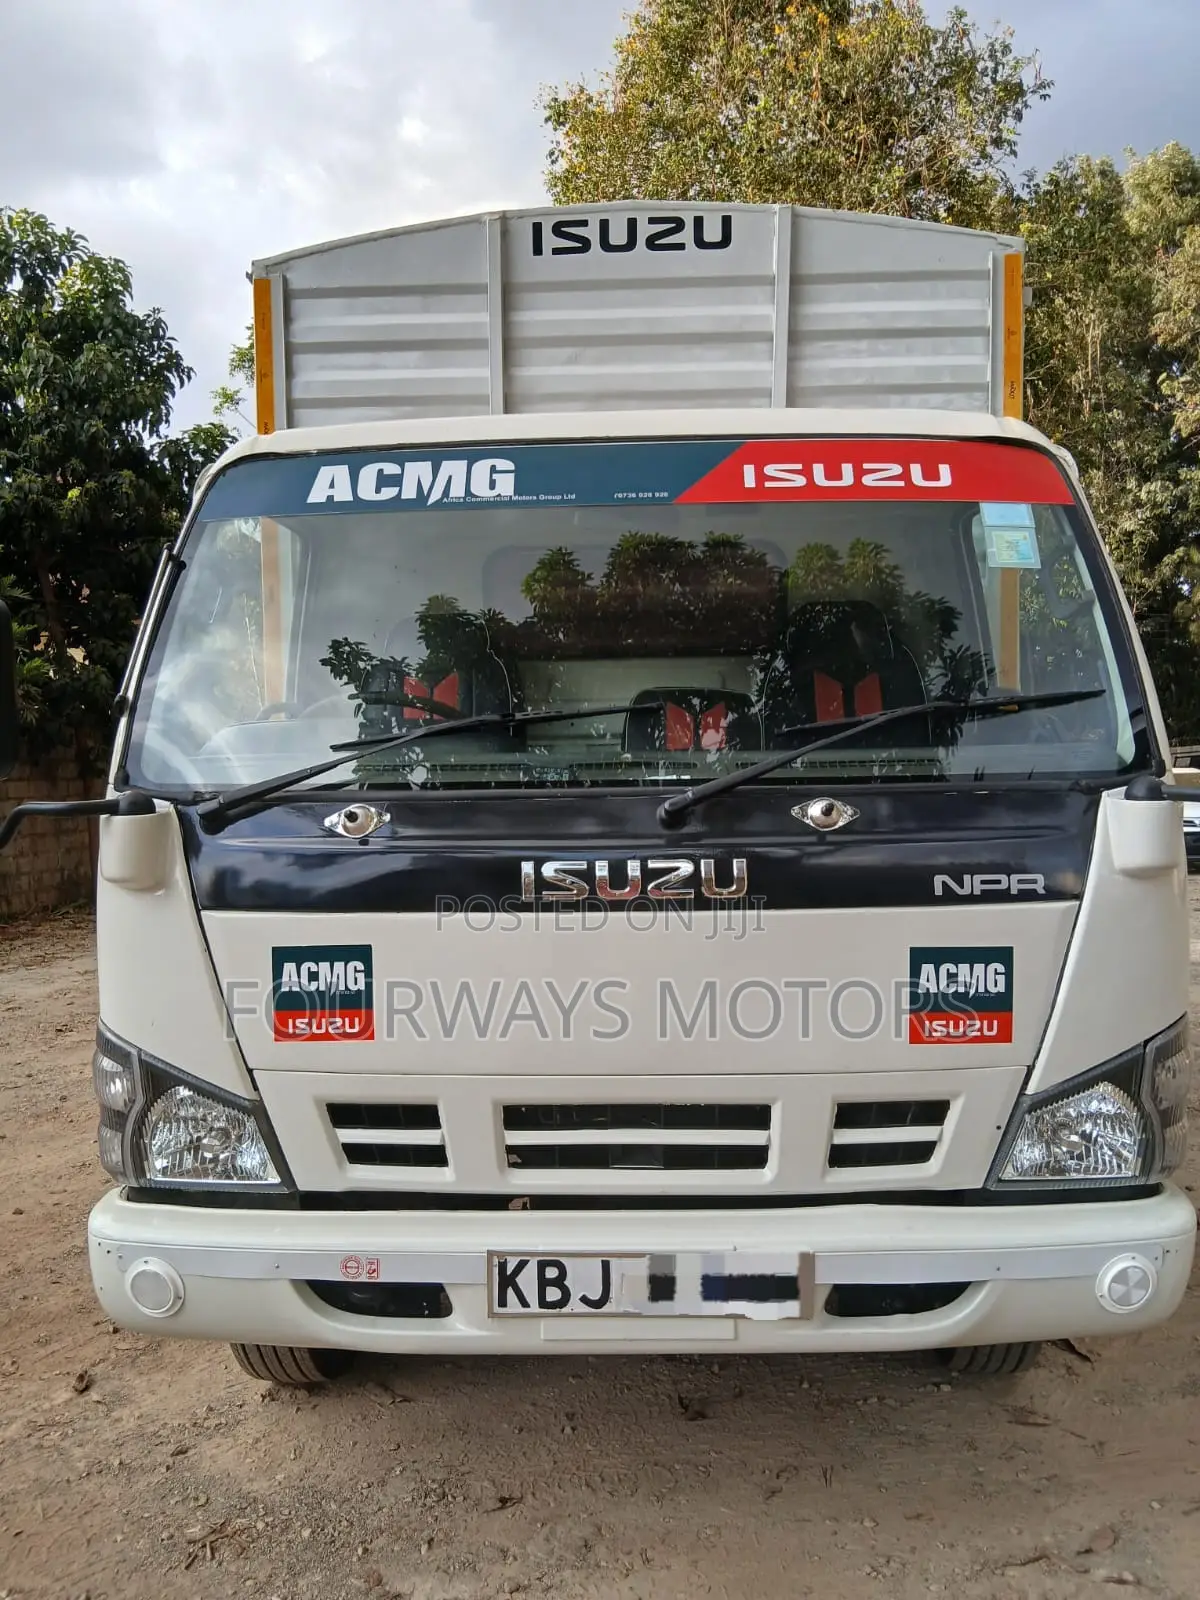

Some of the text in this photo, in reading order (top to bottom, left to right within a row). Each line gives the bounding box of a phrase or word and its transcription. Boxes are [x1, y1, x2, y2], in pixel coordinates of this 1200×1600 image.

[532, 214, 732, 257] ISUZU
[306, 458, 516, 506] ACMG
[742, 462, 953, 490] ISUZU
[465, 494, 510, 503] Commercial
[511, 493, 537, 501] Motors
[538, 493, 562, 501] Group
[563, 492, 576, 500] Ltd
[520, 858, 749, 903] ISUZU
[933, 873, 1047, 897] NPR
[280, 960, 366, 997] ACMG
[918, 962, 1006, 999] ACMG
[287, 1016, 360, 1034] ISUZU
[924, 1019, 998, 1037] ISUZU
[496, 1258, 612, 1310] KBJ
